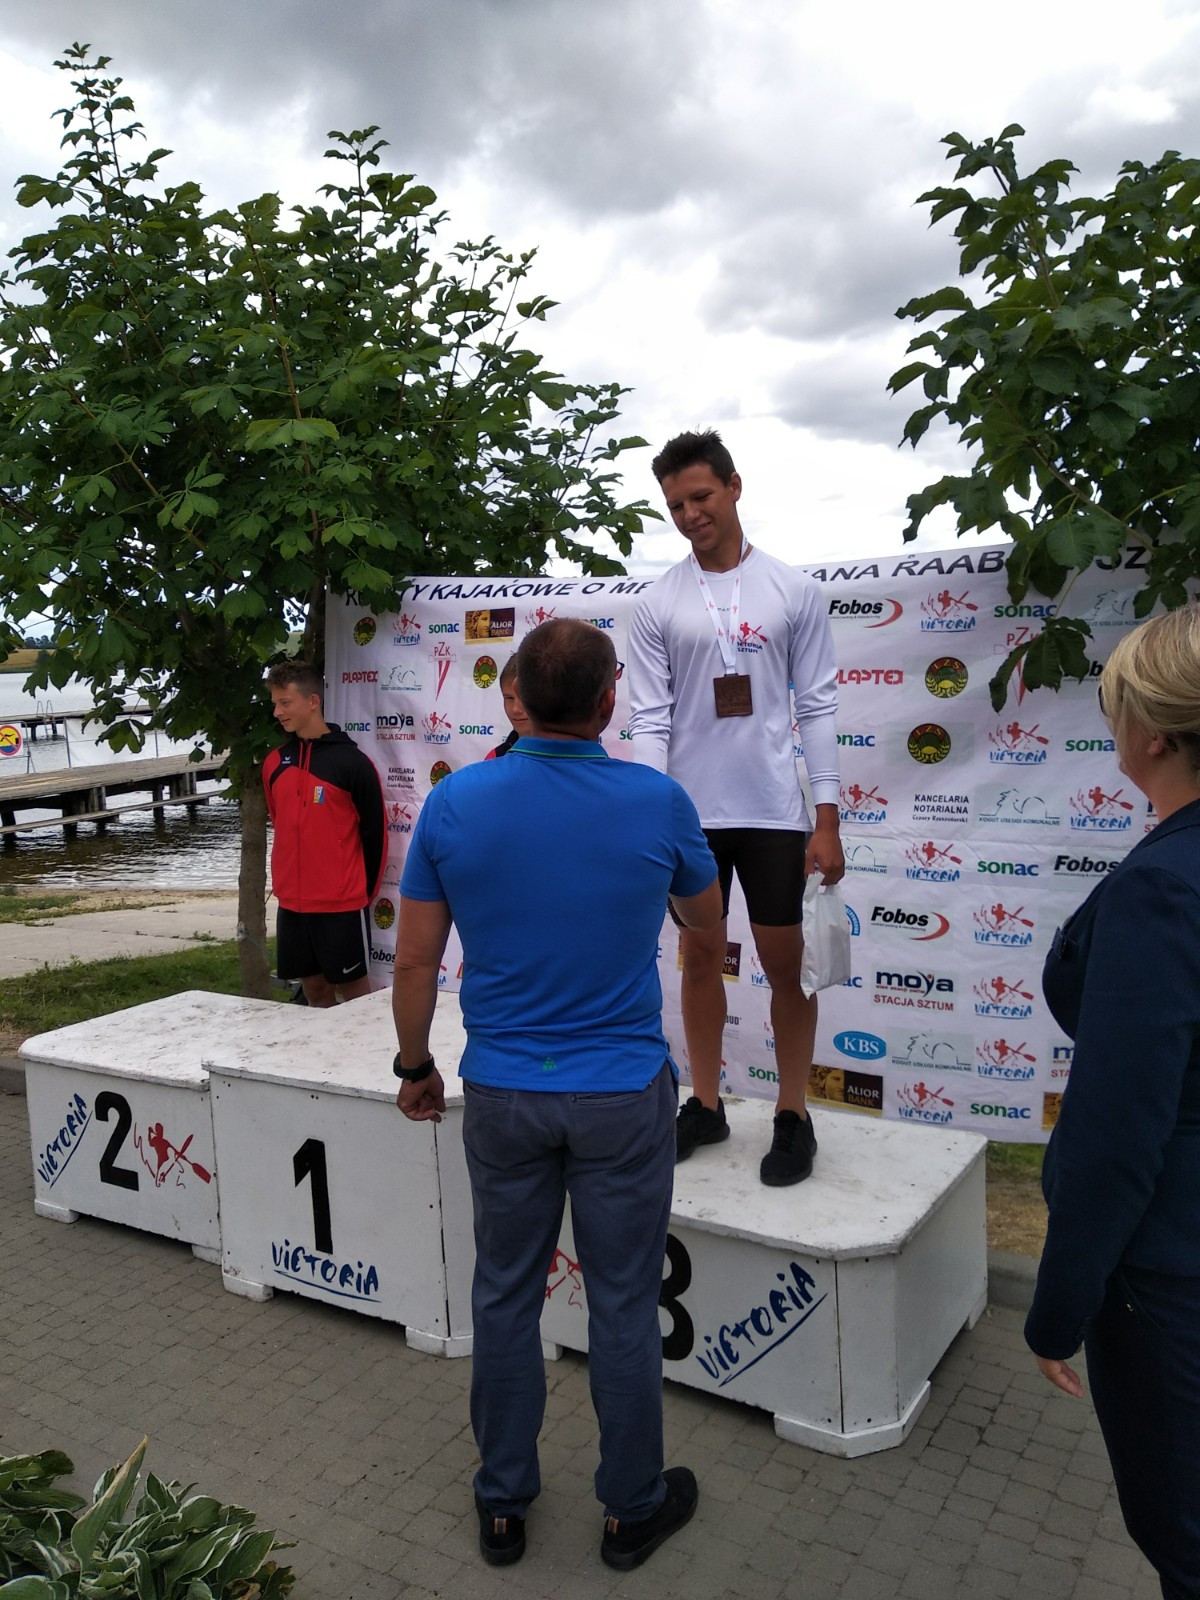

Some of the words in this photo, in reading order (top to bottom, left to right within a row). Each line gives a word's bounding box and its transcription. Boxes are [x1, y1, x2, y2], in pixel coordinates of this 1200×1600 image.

[581, 582, 605, 595] O
[803, 564, 879, 582] ANA
[828, 599, 884, 615] Fobos
[994, 603, 1057, 618] sonac
[429, 622, 460, 634] sonac
[490, 620, 513, 629] ALIOR
[434, 641, 451, 656] PZK
[344, 722, 371, 732] sonac
[458, 724, 494, 735] sonac
[1065, 738, 1116, 752] sona
[914, 794, 969, 804] KANCELARIA
[913, 804, 968, 814] NOTARIALNA
[977, 860, 1040, 877] sonac
[870, 906, 929, 927] Fobos
[874, 994, 915, 1008] STACJA
[917, 999, 954, 1011] SZTUM
[843, 1036, 880, 1056] KBS
[748, 1066, 779, 1084] son
[847, 1085, 880, 1099] ALIOR
[969, 1102, 1031, 1119] sonac
[95, 1091, 140, 1191] 2
[292, 1138, 333, 1255] 1
[657, 1233, 694, 1361] 3
